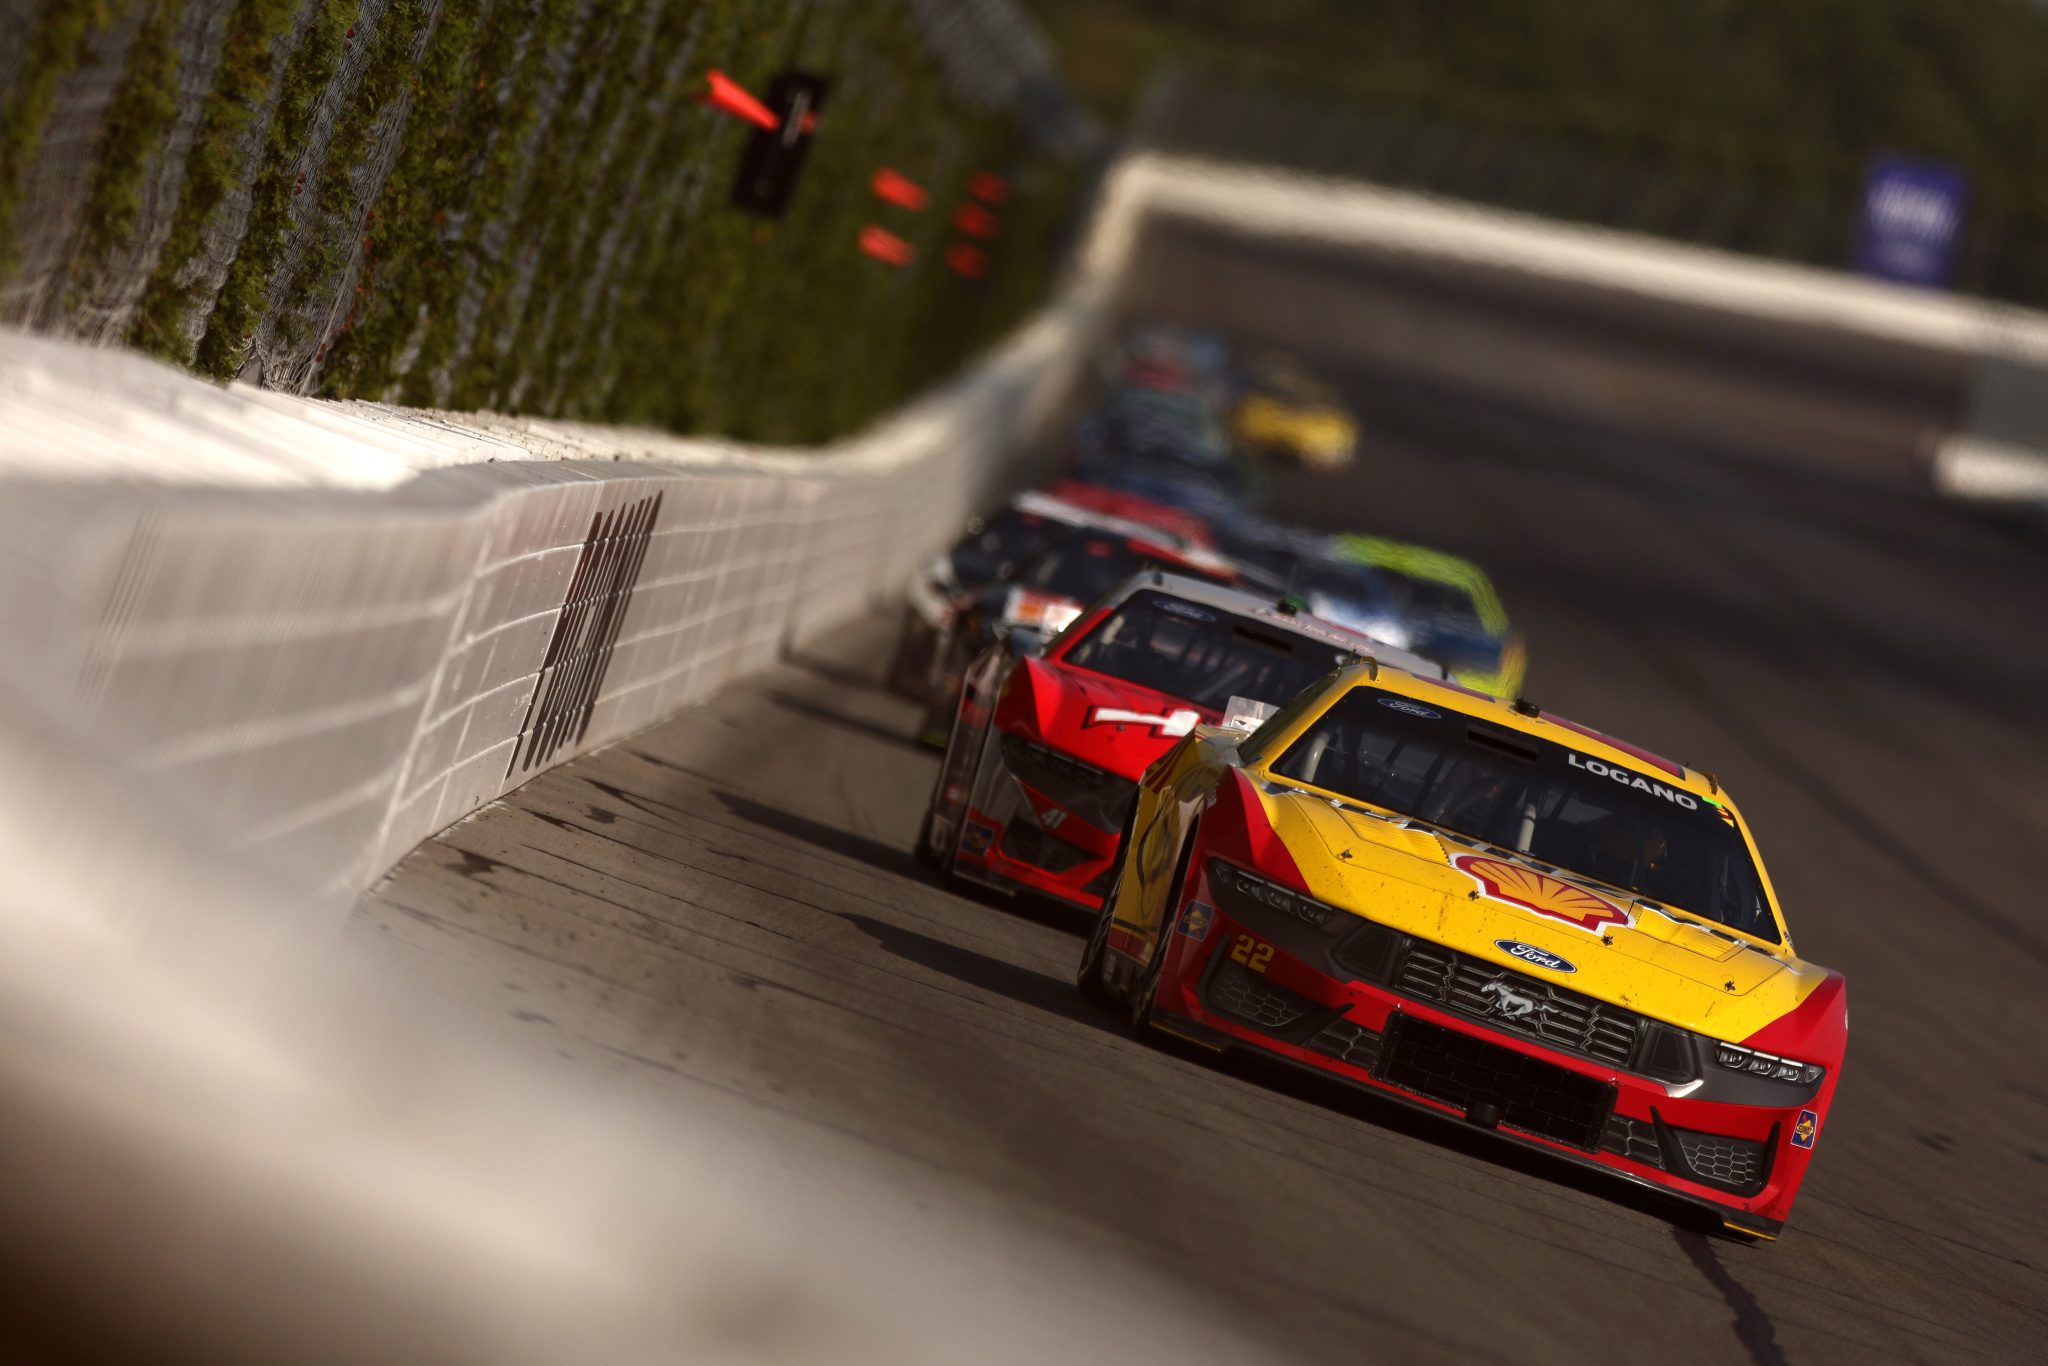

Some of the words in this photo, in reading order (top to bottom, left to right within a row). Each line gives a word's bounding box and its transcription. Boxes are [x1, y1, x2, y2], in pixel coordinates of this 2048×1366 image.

[1568, 752, 1698, 811] LOGANO
[1041, 808, 1067, 830] 41
[1230, 933, 1275, 974] 22
[1510, 943, 1561, 969] Ford
